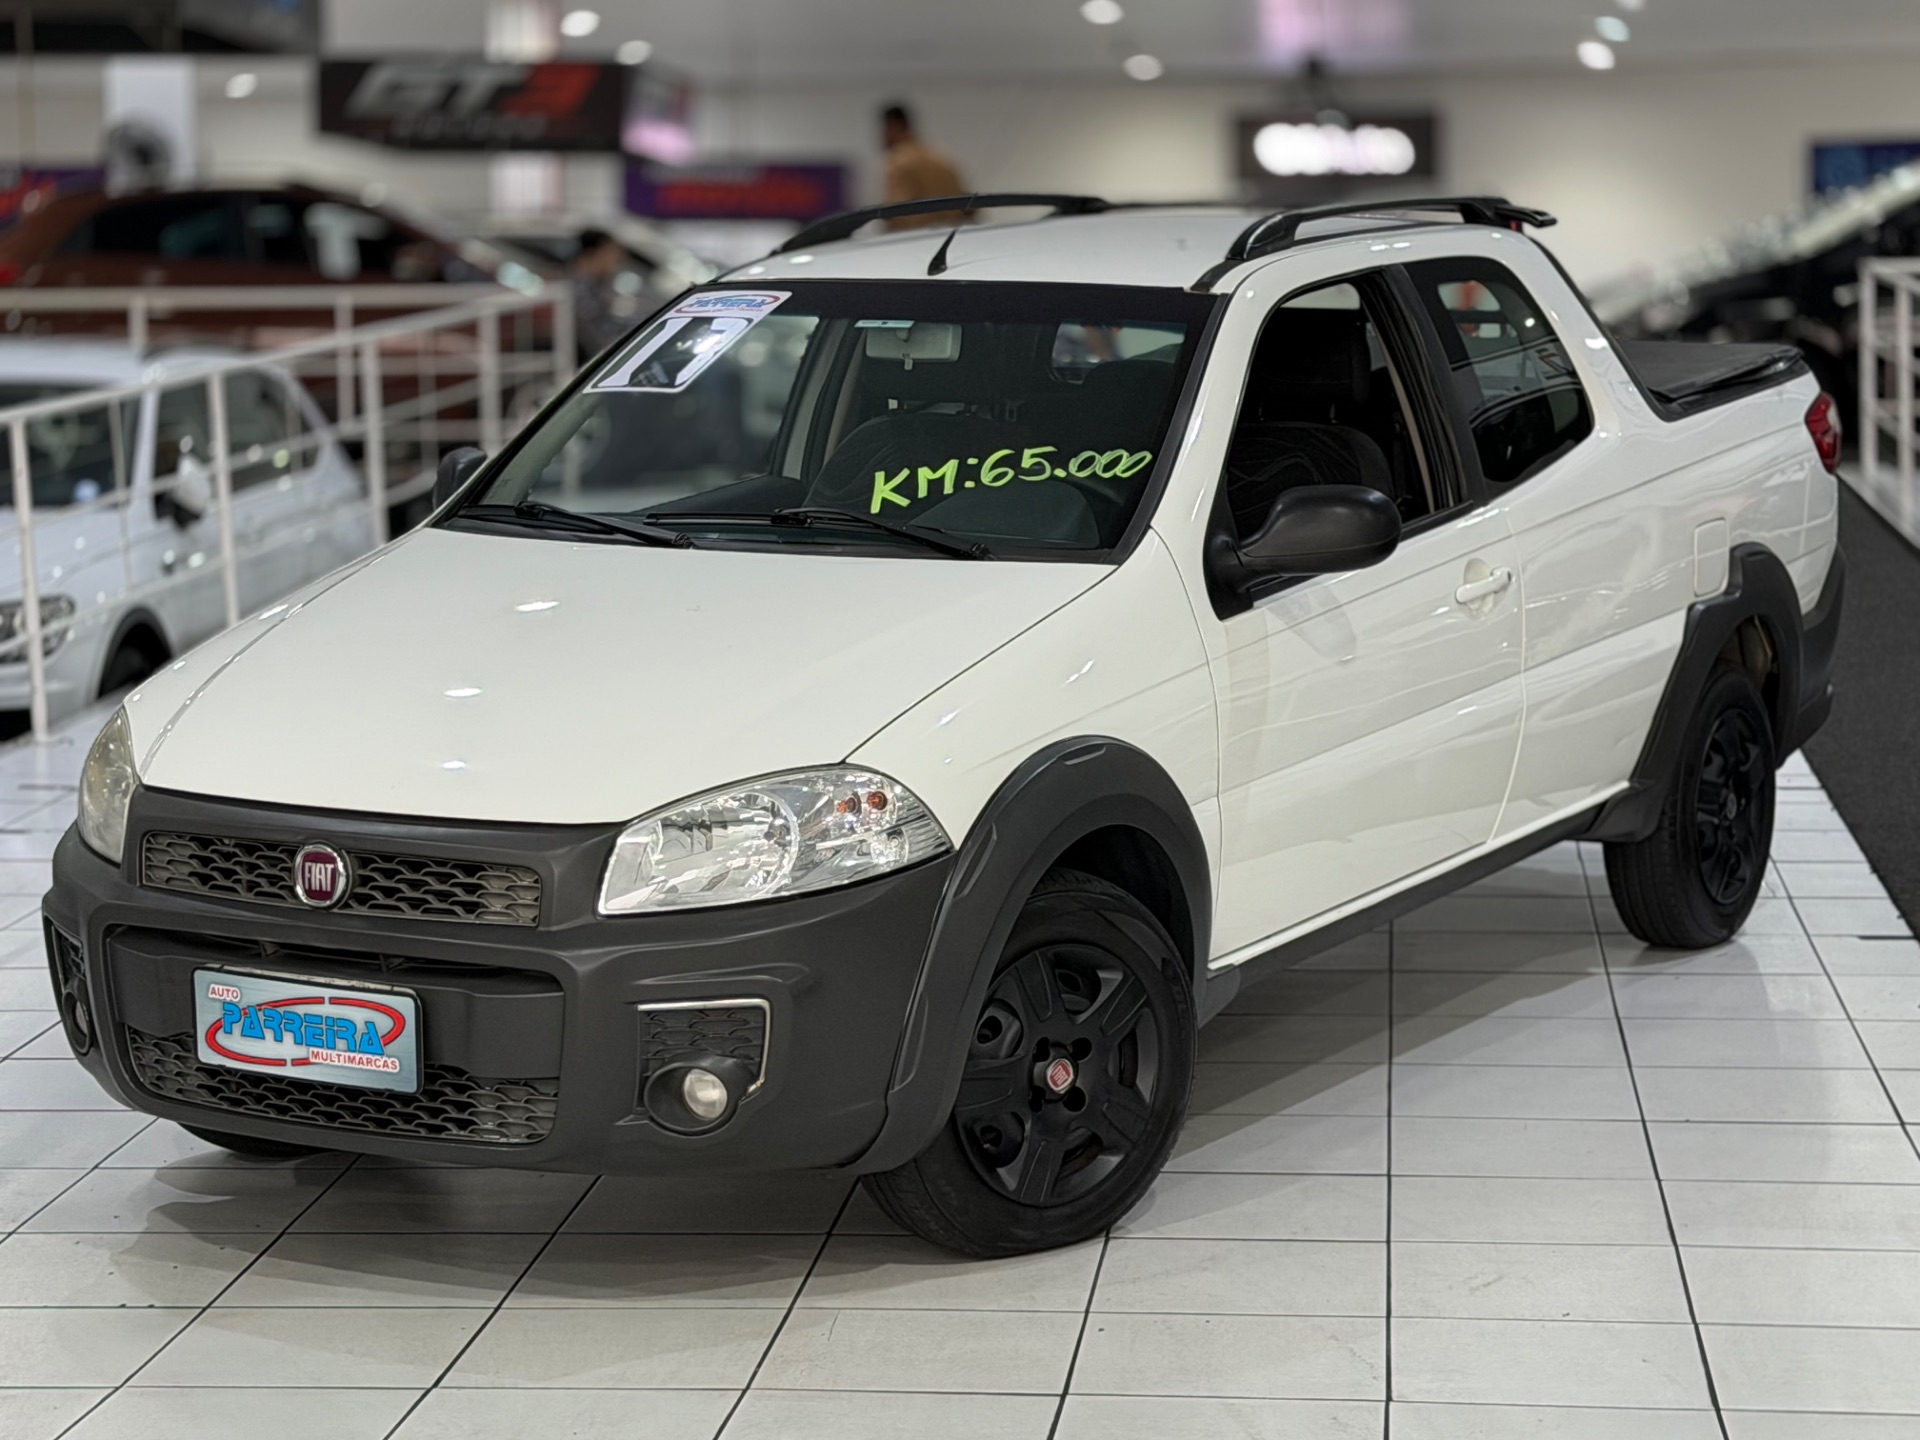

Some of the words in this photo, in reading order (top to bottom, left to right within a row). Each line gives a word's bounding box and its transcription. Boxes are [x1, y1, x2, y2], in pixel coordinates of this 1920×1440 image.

[597, 317, 749, 387] 17
[870, 446, 1153, 514] KM:65.000
[304, 862, 335, 892] FIAT
[209, 986, 240, 1000] AUTO
[222, 1001, 385, 1056] PARREIRA
[311, 1049, 399, 1071] MULTIMARCAS
